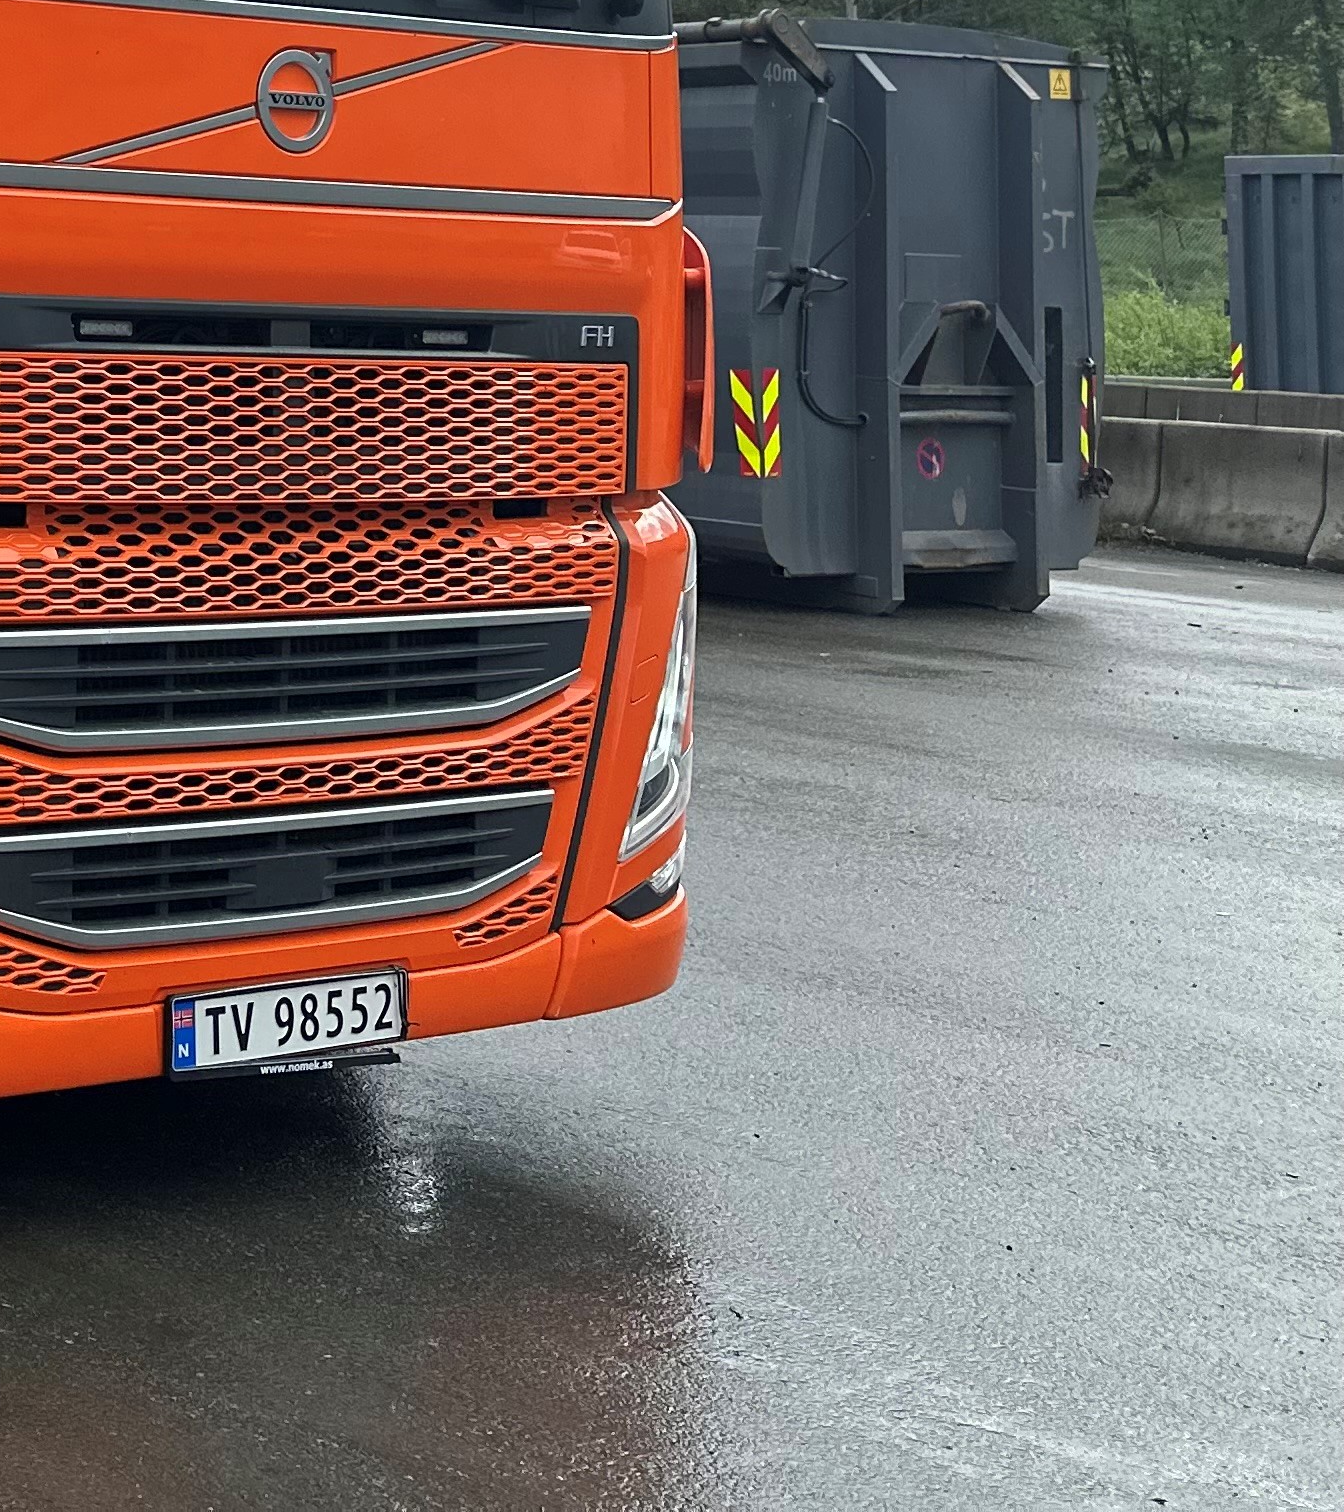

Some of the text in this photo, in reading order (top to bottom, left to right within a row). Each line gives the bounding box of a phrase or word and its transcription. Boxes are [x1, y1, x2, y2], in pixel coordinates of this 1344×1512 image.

[269, 92, 326, 108] VOLVO
[580, 325, 615, 347] FH
[205, 983, 394, 1056] TV 98552
[177, 1043, 190, 1059] N
[260, 1059, 334, 1076] www.nomek.as
